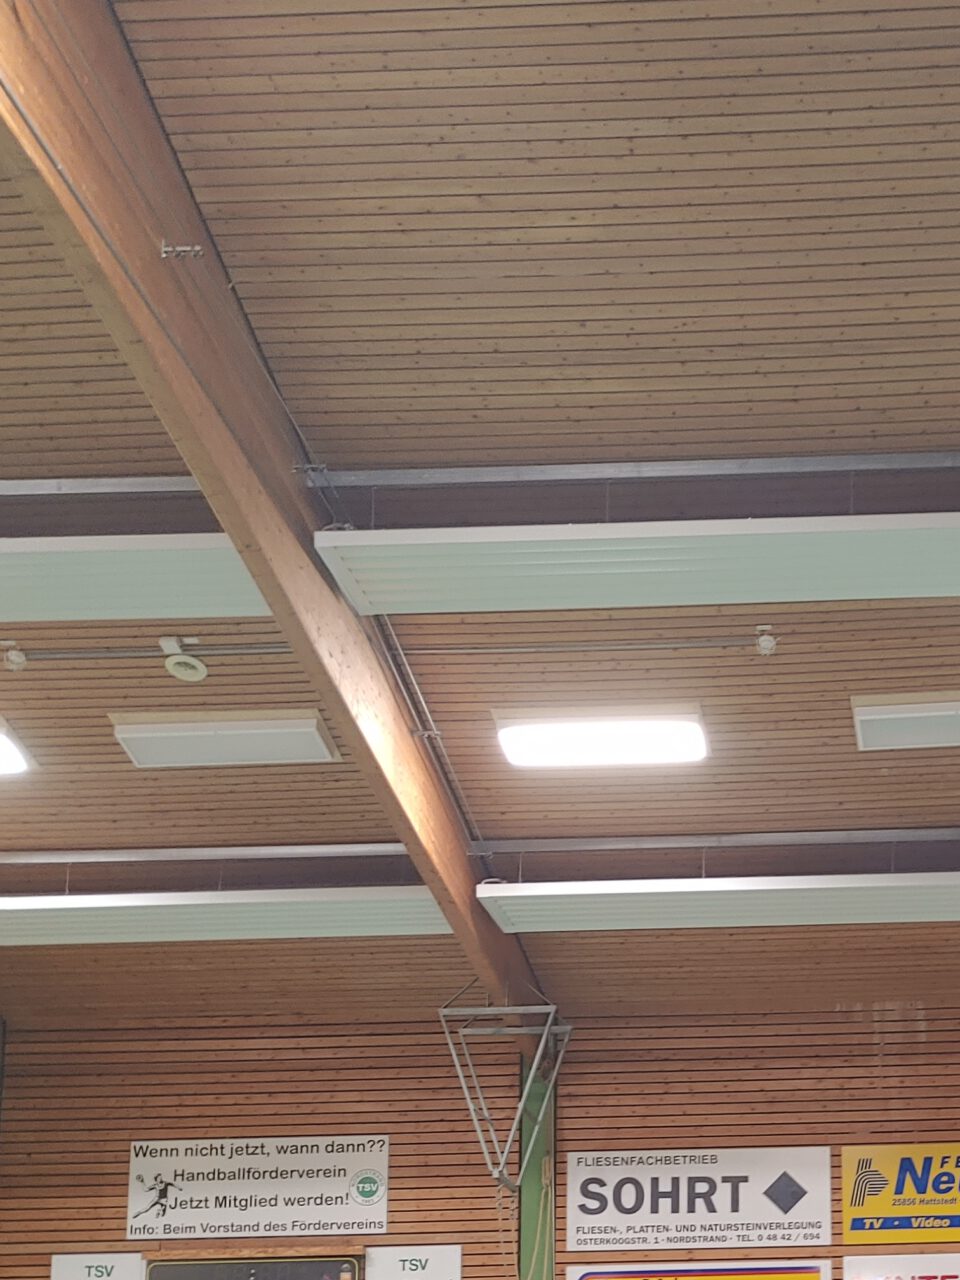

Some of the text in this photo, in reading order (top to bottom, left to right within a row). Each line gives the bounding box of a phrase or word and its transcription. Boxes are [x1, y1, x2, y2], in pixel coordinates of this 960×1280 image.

[133, 1139, 386, 1159] Wenn nicht jetzt, wann dann??
[577, 1154, 719, 1167] FLIESENFACHBETRIEB
[173, 1165, 347, 1182] Handballförderverein
[357, 1183, 378, 1191] TSV
[168, 1192, 350, 1211] Jetzt Mitglied werden!
[577, 1175, 749, 1215] SOHRT
[130, 1219, 384, 1235] Info: Beim Vorstand des Fördervereins
[626, 1224, 673, 1234] PLATTEN-
[675, 1224, 697, 1233] UND
[700, 1221, 822, 1232] NATURSTEINVERLEGUNG
[863, 1218, 884, 1229] TV
[911, 1216, 950, 1229] Video
[576, 1235, 651, 1246] OSTERKOOGSTR.
[666, 1234, 727, 1244] NORDSTRAND
[85, 1265, 115, 1278] TSV
[399, 1259, 428, 1271] TSV
